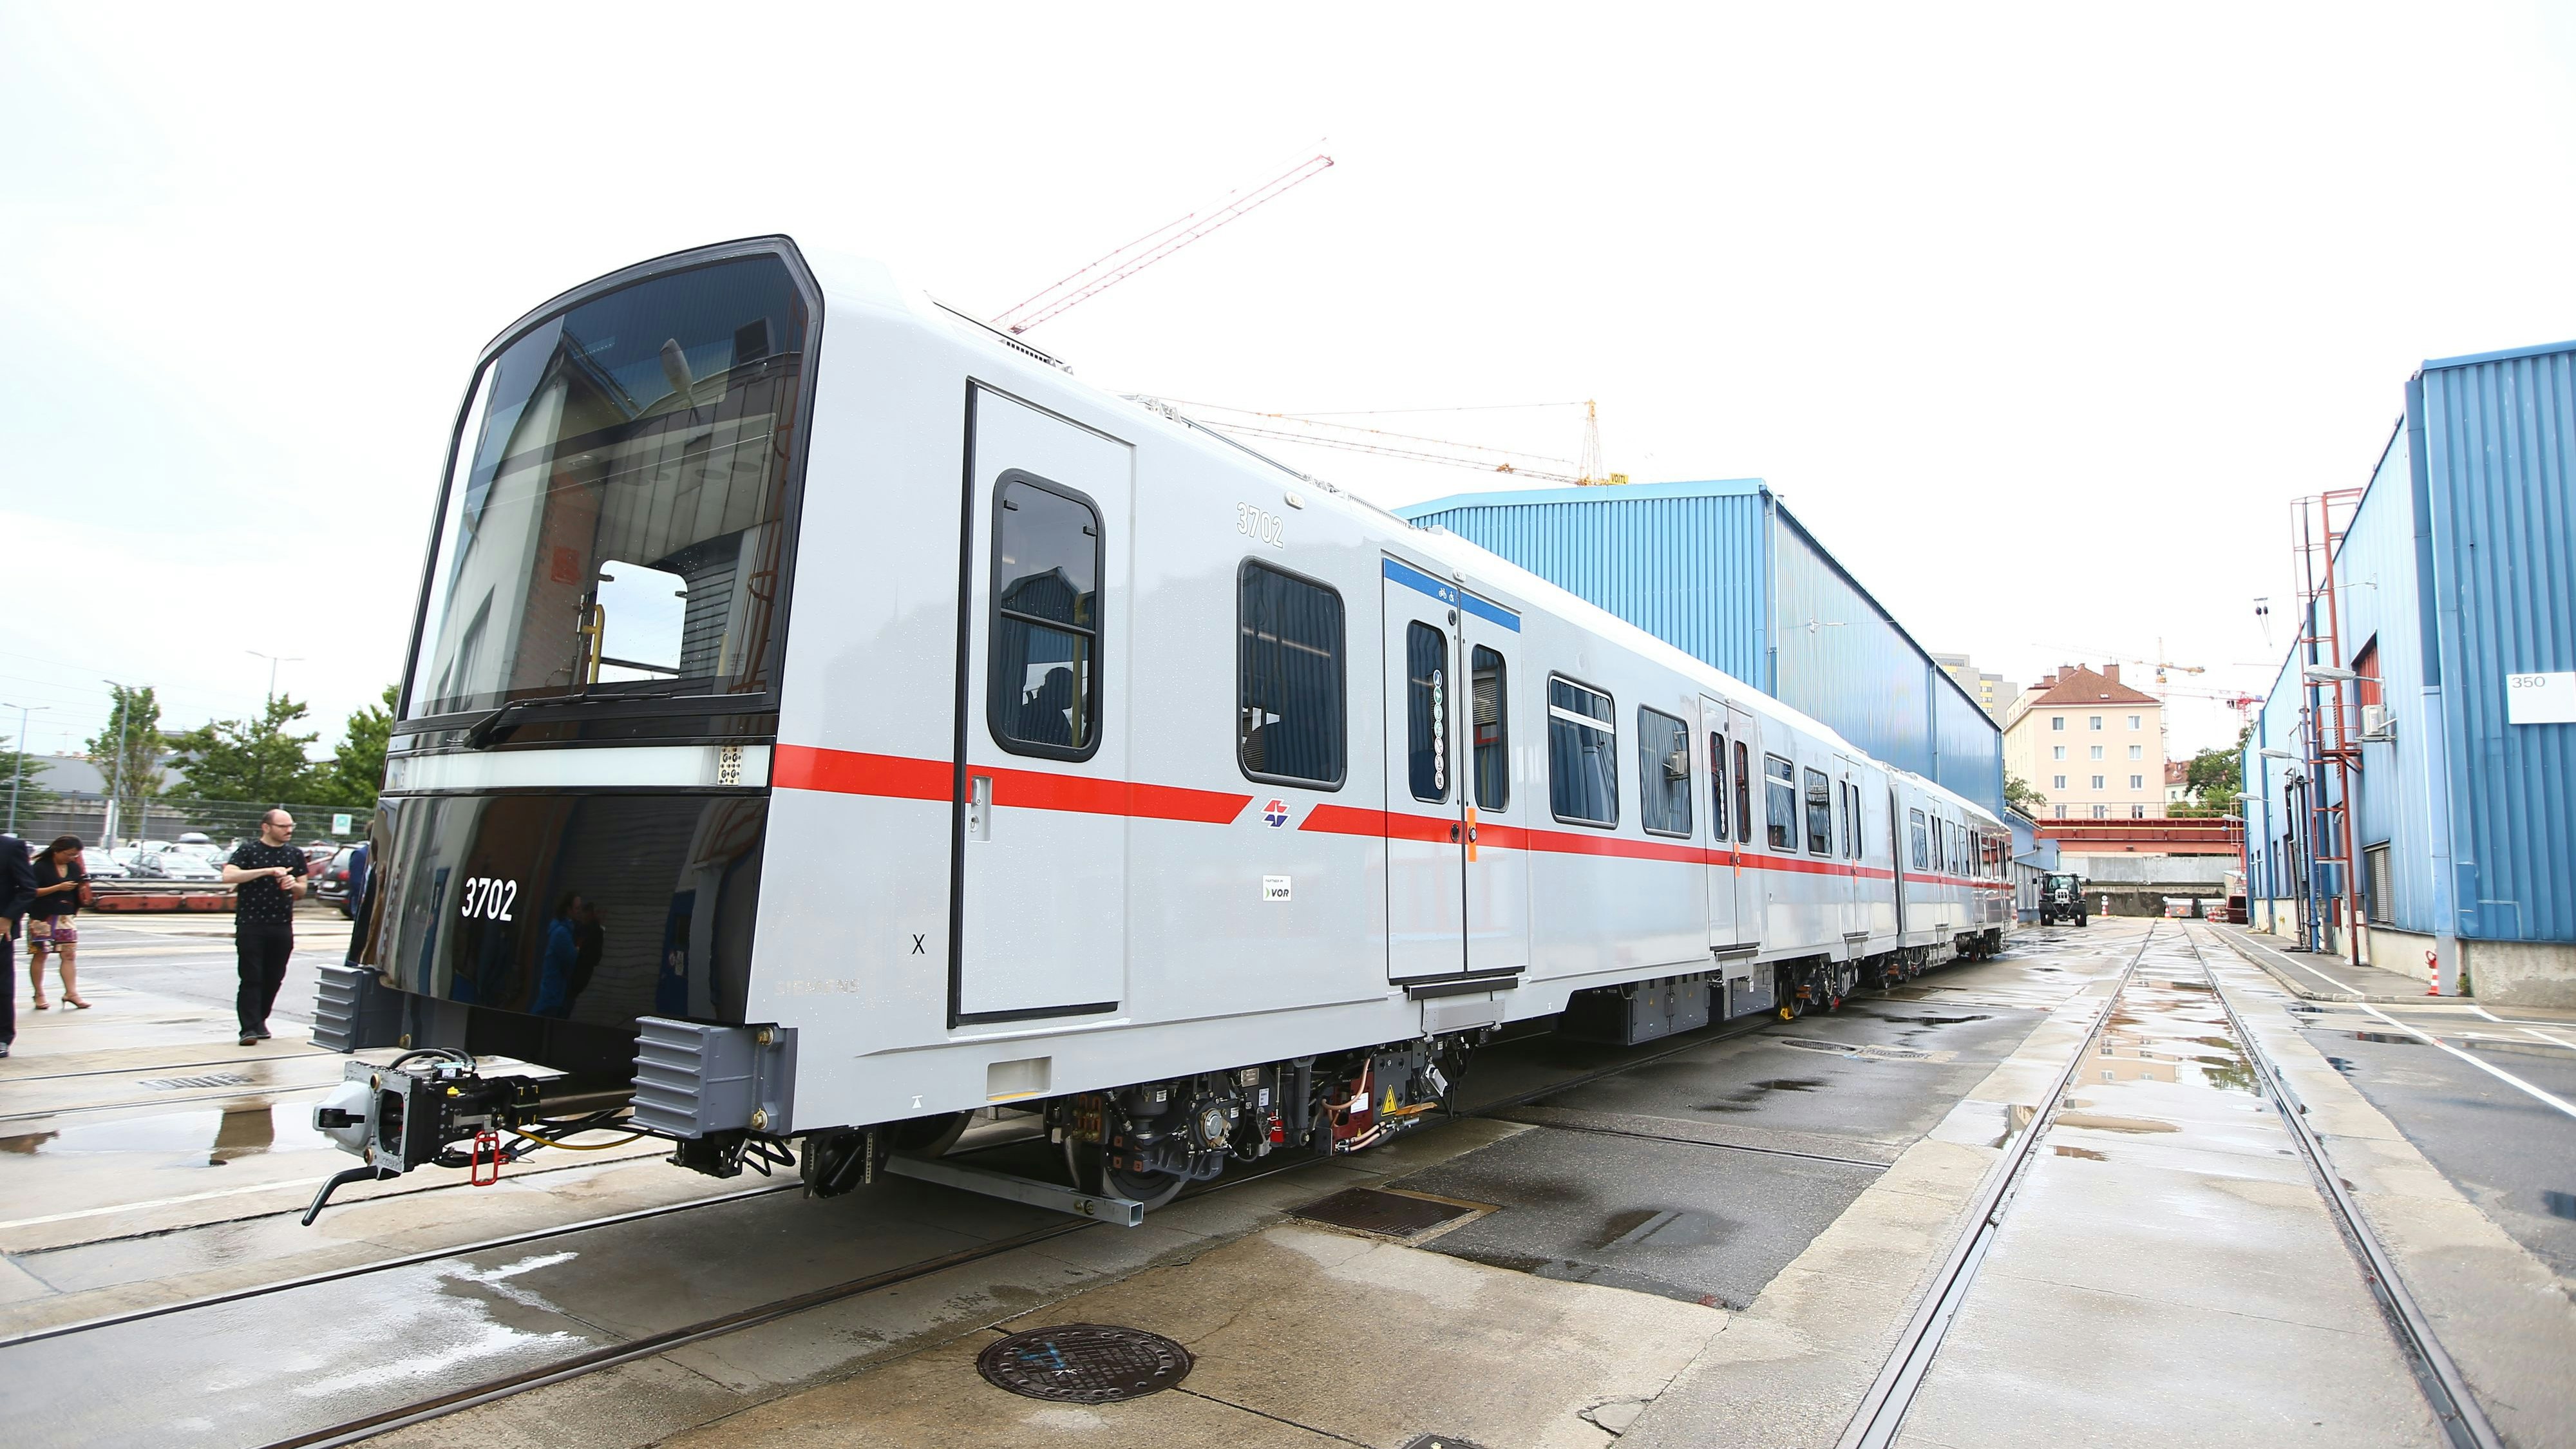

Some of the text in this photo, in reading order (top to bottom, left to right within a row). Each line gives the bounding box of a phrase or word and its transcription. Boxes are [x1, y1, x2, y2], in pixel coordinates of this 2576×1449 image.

[1236, 502, 1283, 549] 3702
[2512, 676, 2546, 688] 350
[461, 876, 517, 922] 3702
[1271, 889, 1289, 897] VOR
[912, 934, 925, 954] X
